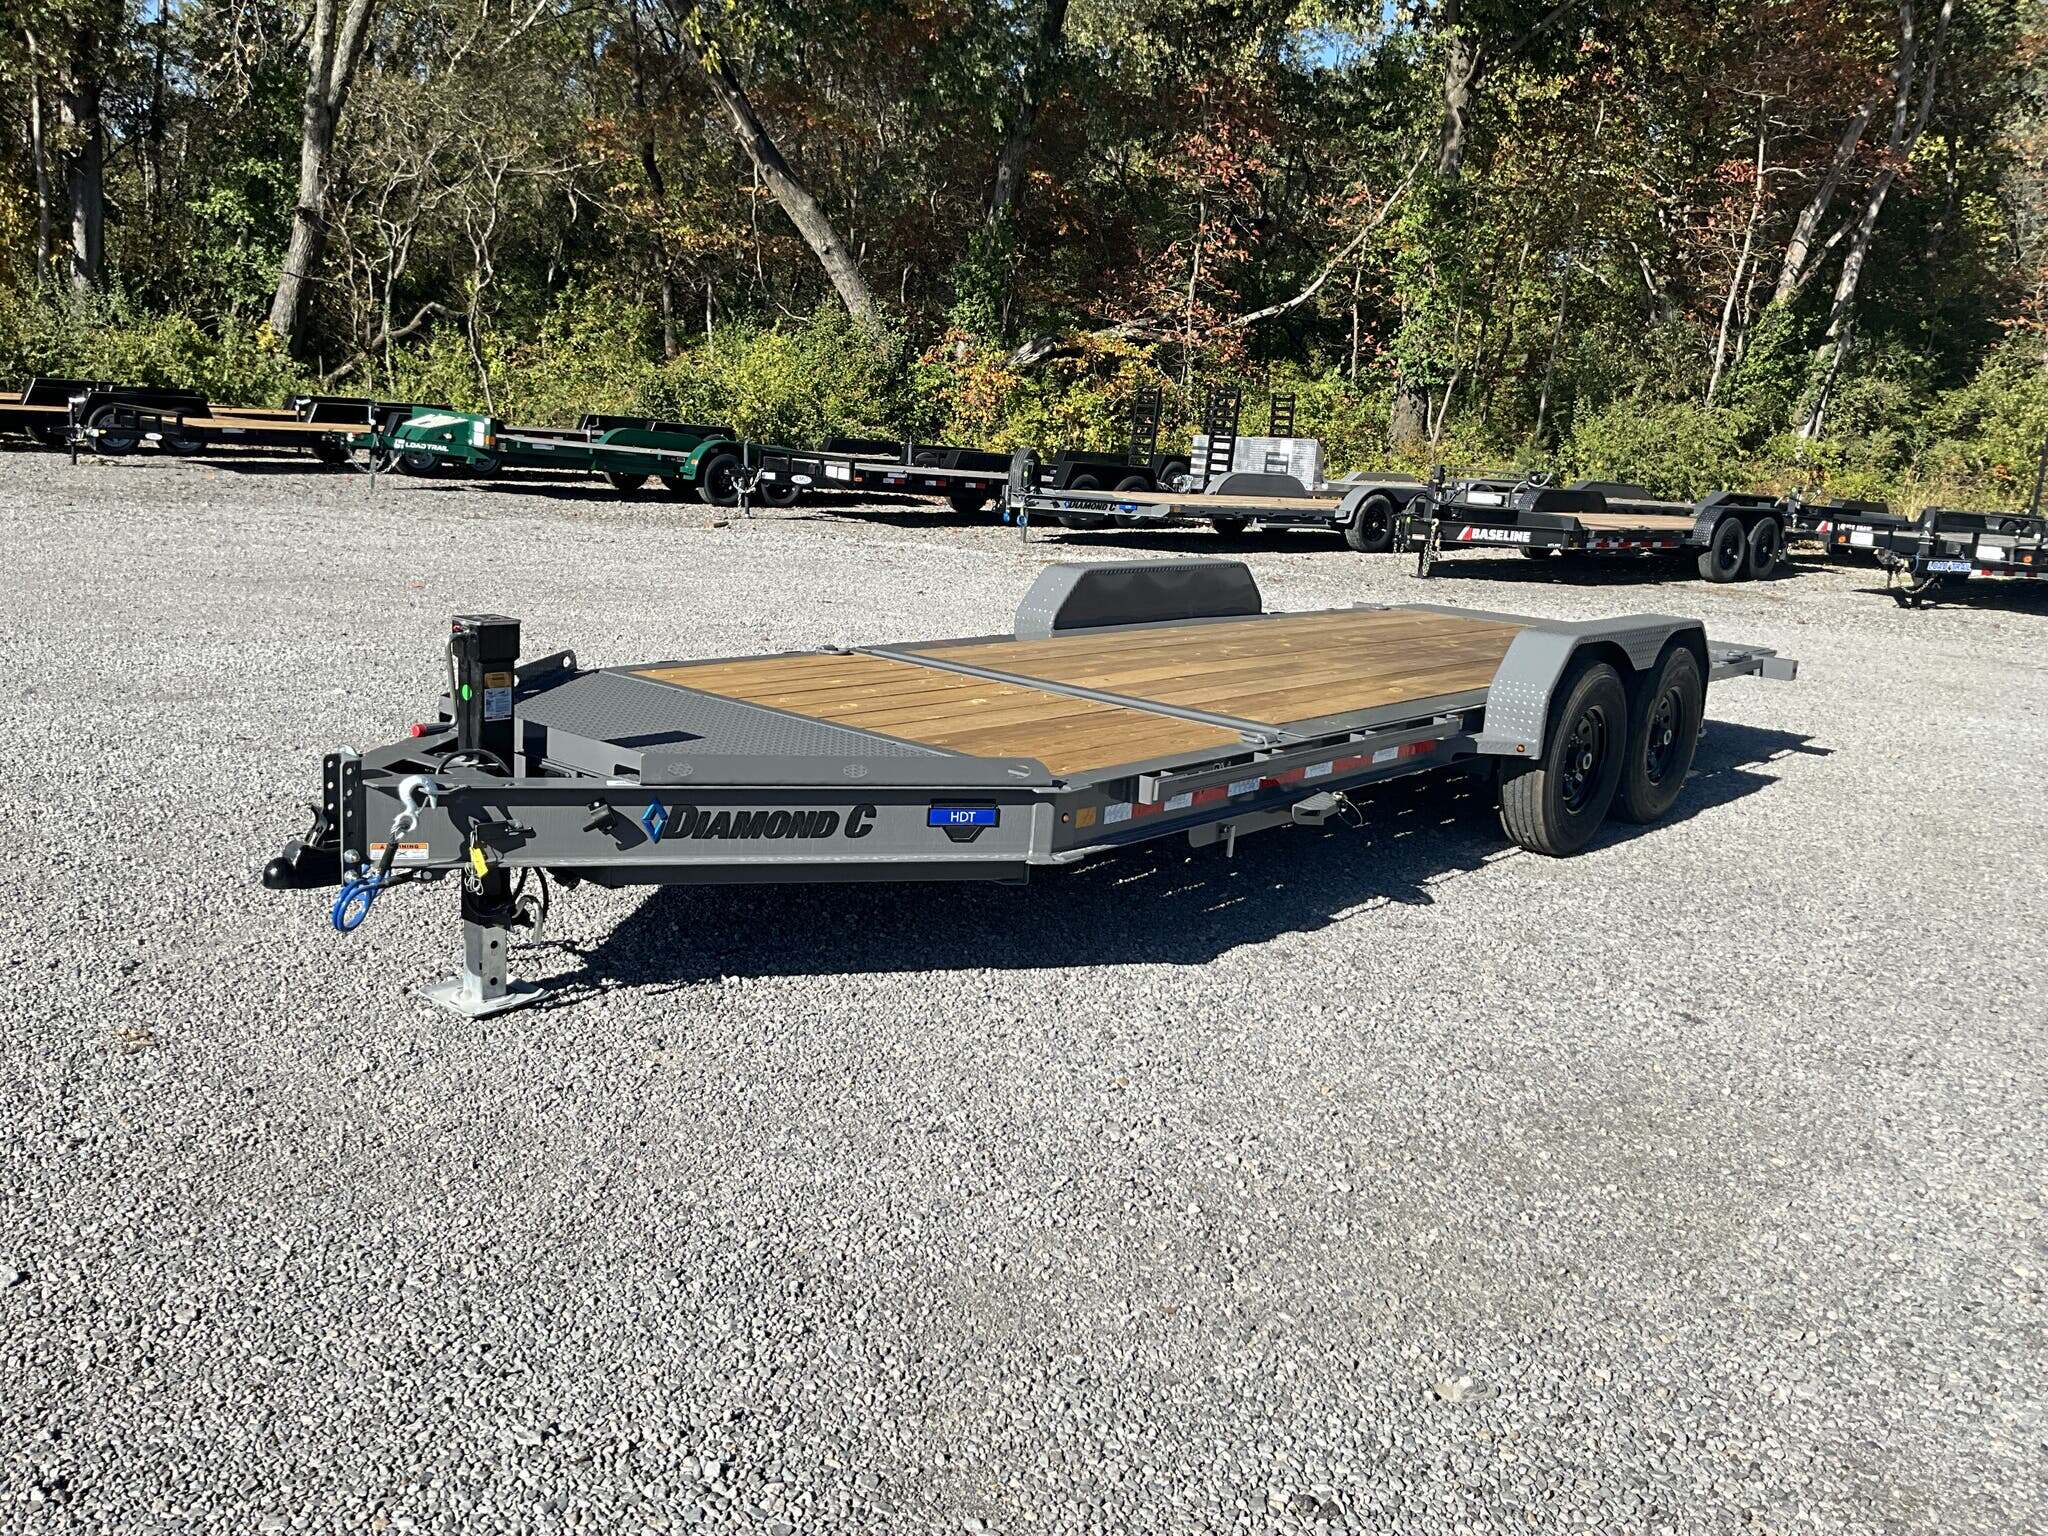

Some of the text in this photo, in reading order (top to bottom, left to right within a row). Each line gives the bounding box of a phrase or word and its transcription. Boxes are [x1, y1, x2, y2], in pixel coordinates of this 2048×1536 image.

[405, 441, 449, 452] LOAD TRAIL
[1069, 500, 1108, 511] DIAMOND
[1109, 503, 1116, 512] C
[1471, 527, 1532, 543] BASELINE
[662, 803, 878, 840] DIAMOND C
[950, 810, 977, 823] HDT
